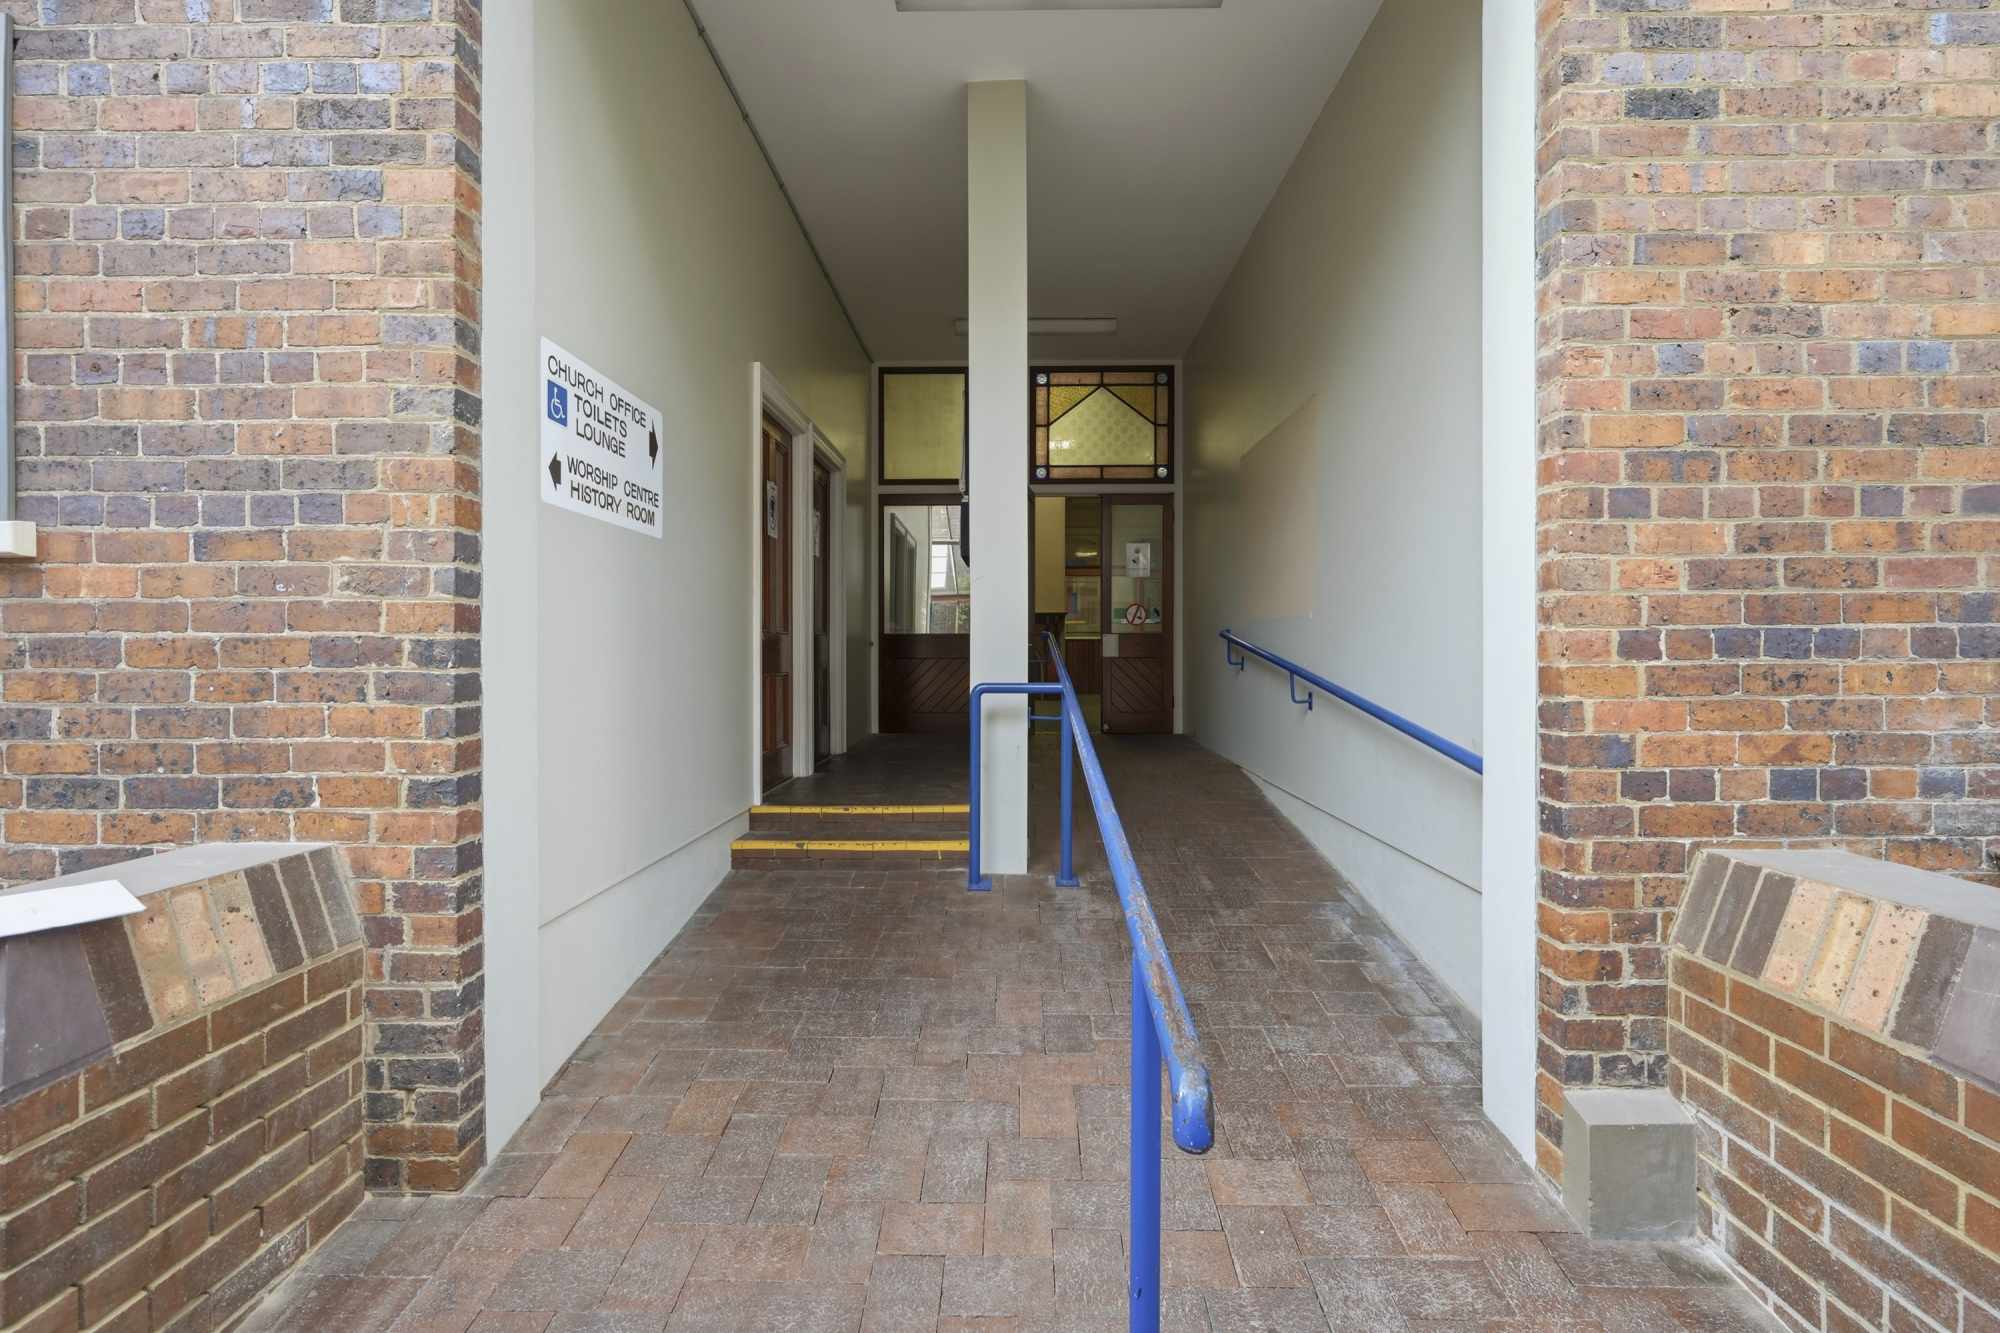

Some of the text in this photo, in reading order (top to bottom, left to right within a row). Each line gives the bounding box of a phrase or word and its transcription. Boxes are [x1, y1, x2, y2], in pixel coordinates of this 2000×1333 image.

[547, 355, 647, 428] CHURCH OFFICE
[574, 393, 628, 438] TOILETS
[576, 418, 626, 458] LOUNGE
[566, 455, 659, 508] WORSHIP CENTRE
[571, 480, 655, 527] HISTORY ROOM
